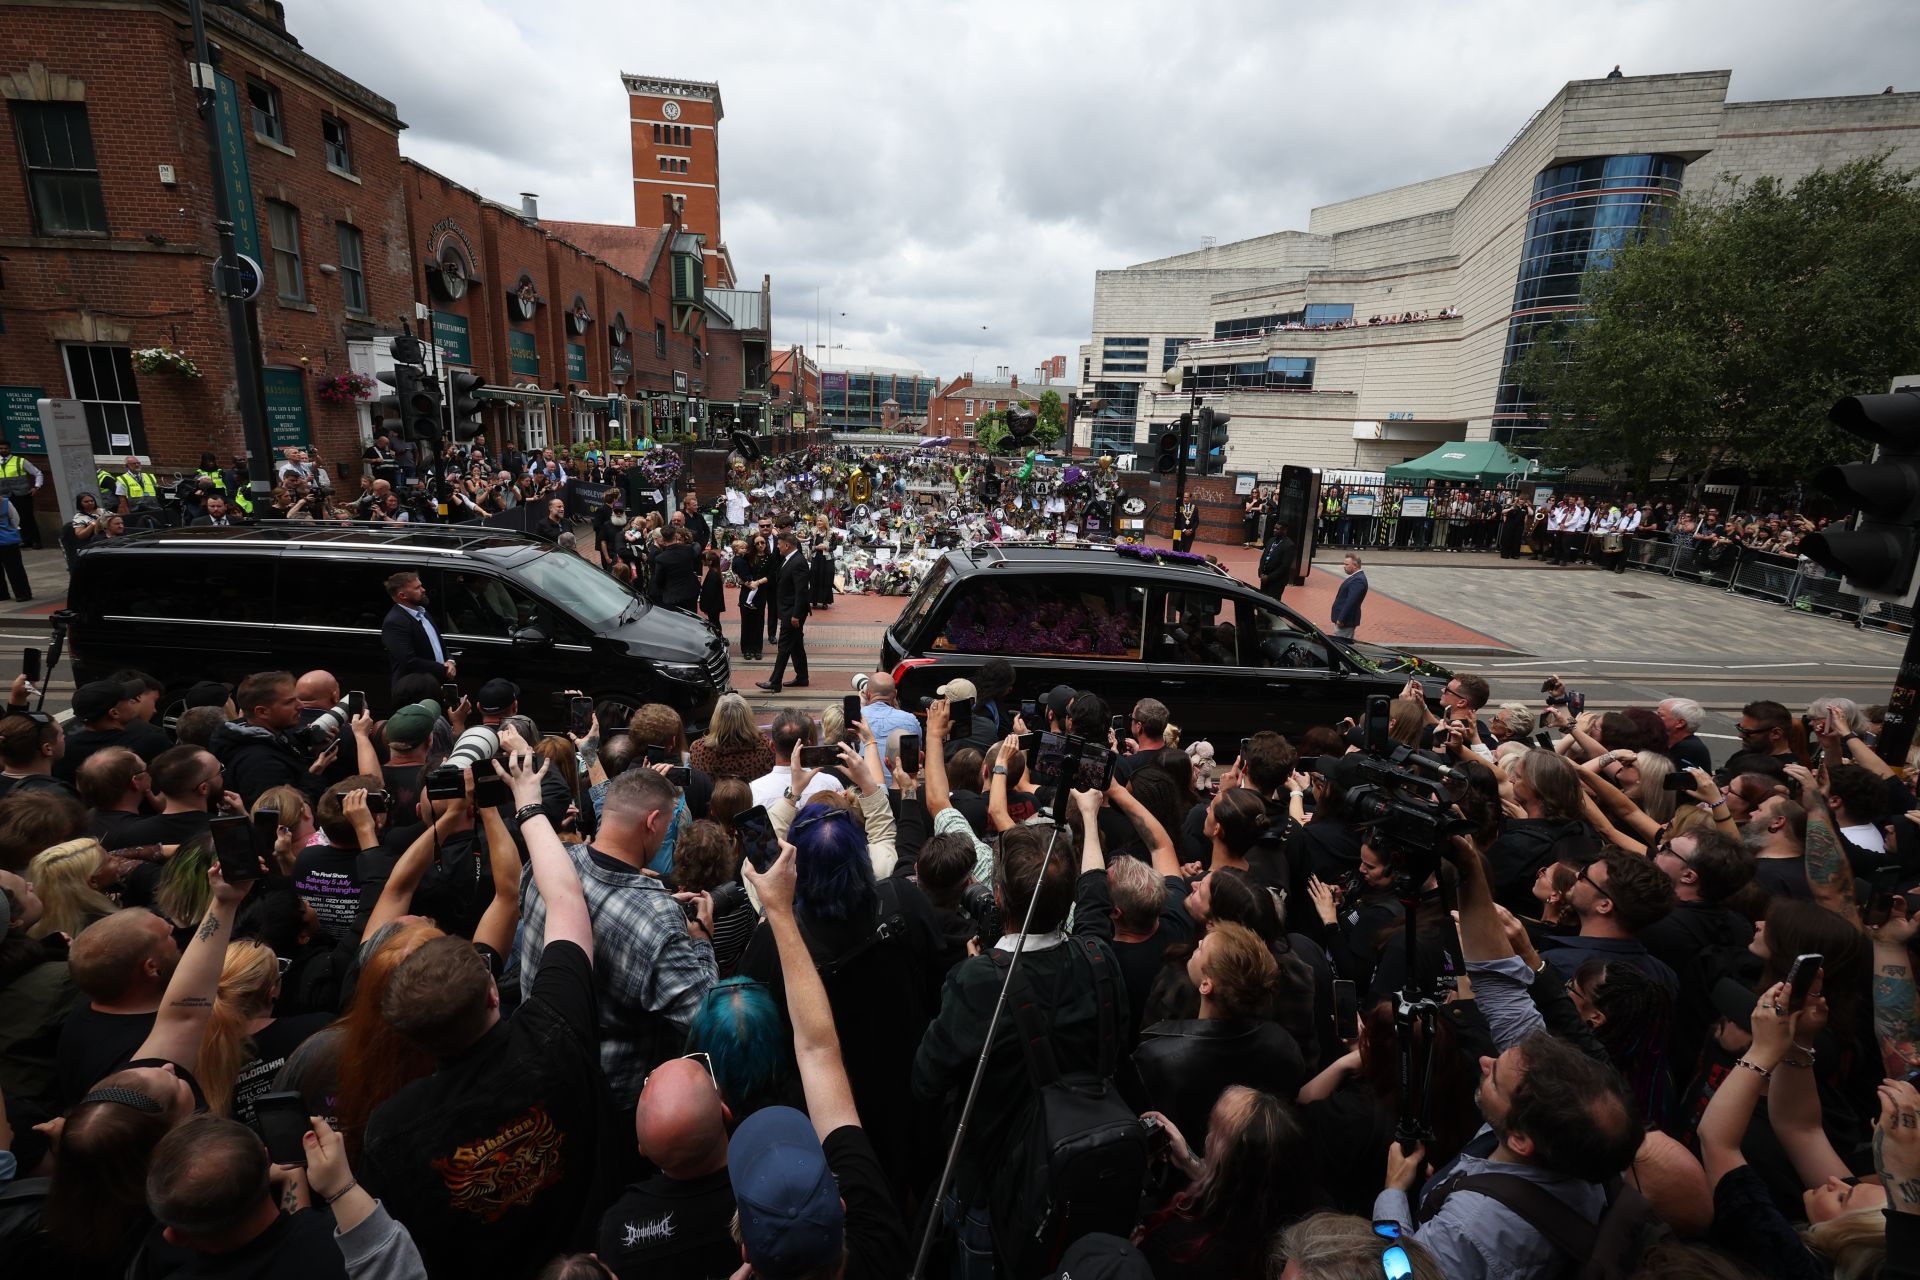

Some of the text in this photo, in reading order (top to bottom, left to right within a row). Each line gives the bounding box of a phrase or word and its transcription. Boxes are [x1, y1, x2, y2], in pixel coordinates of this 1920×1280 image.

[220, 80, 251, 250] BRASSHOUS
[305, 875, 331, 885] Saturday
[452, 1119, 535, 1163] Sabaton
